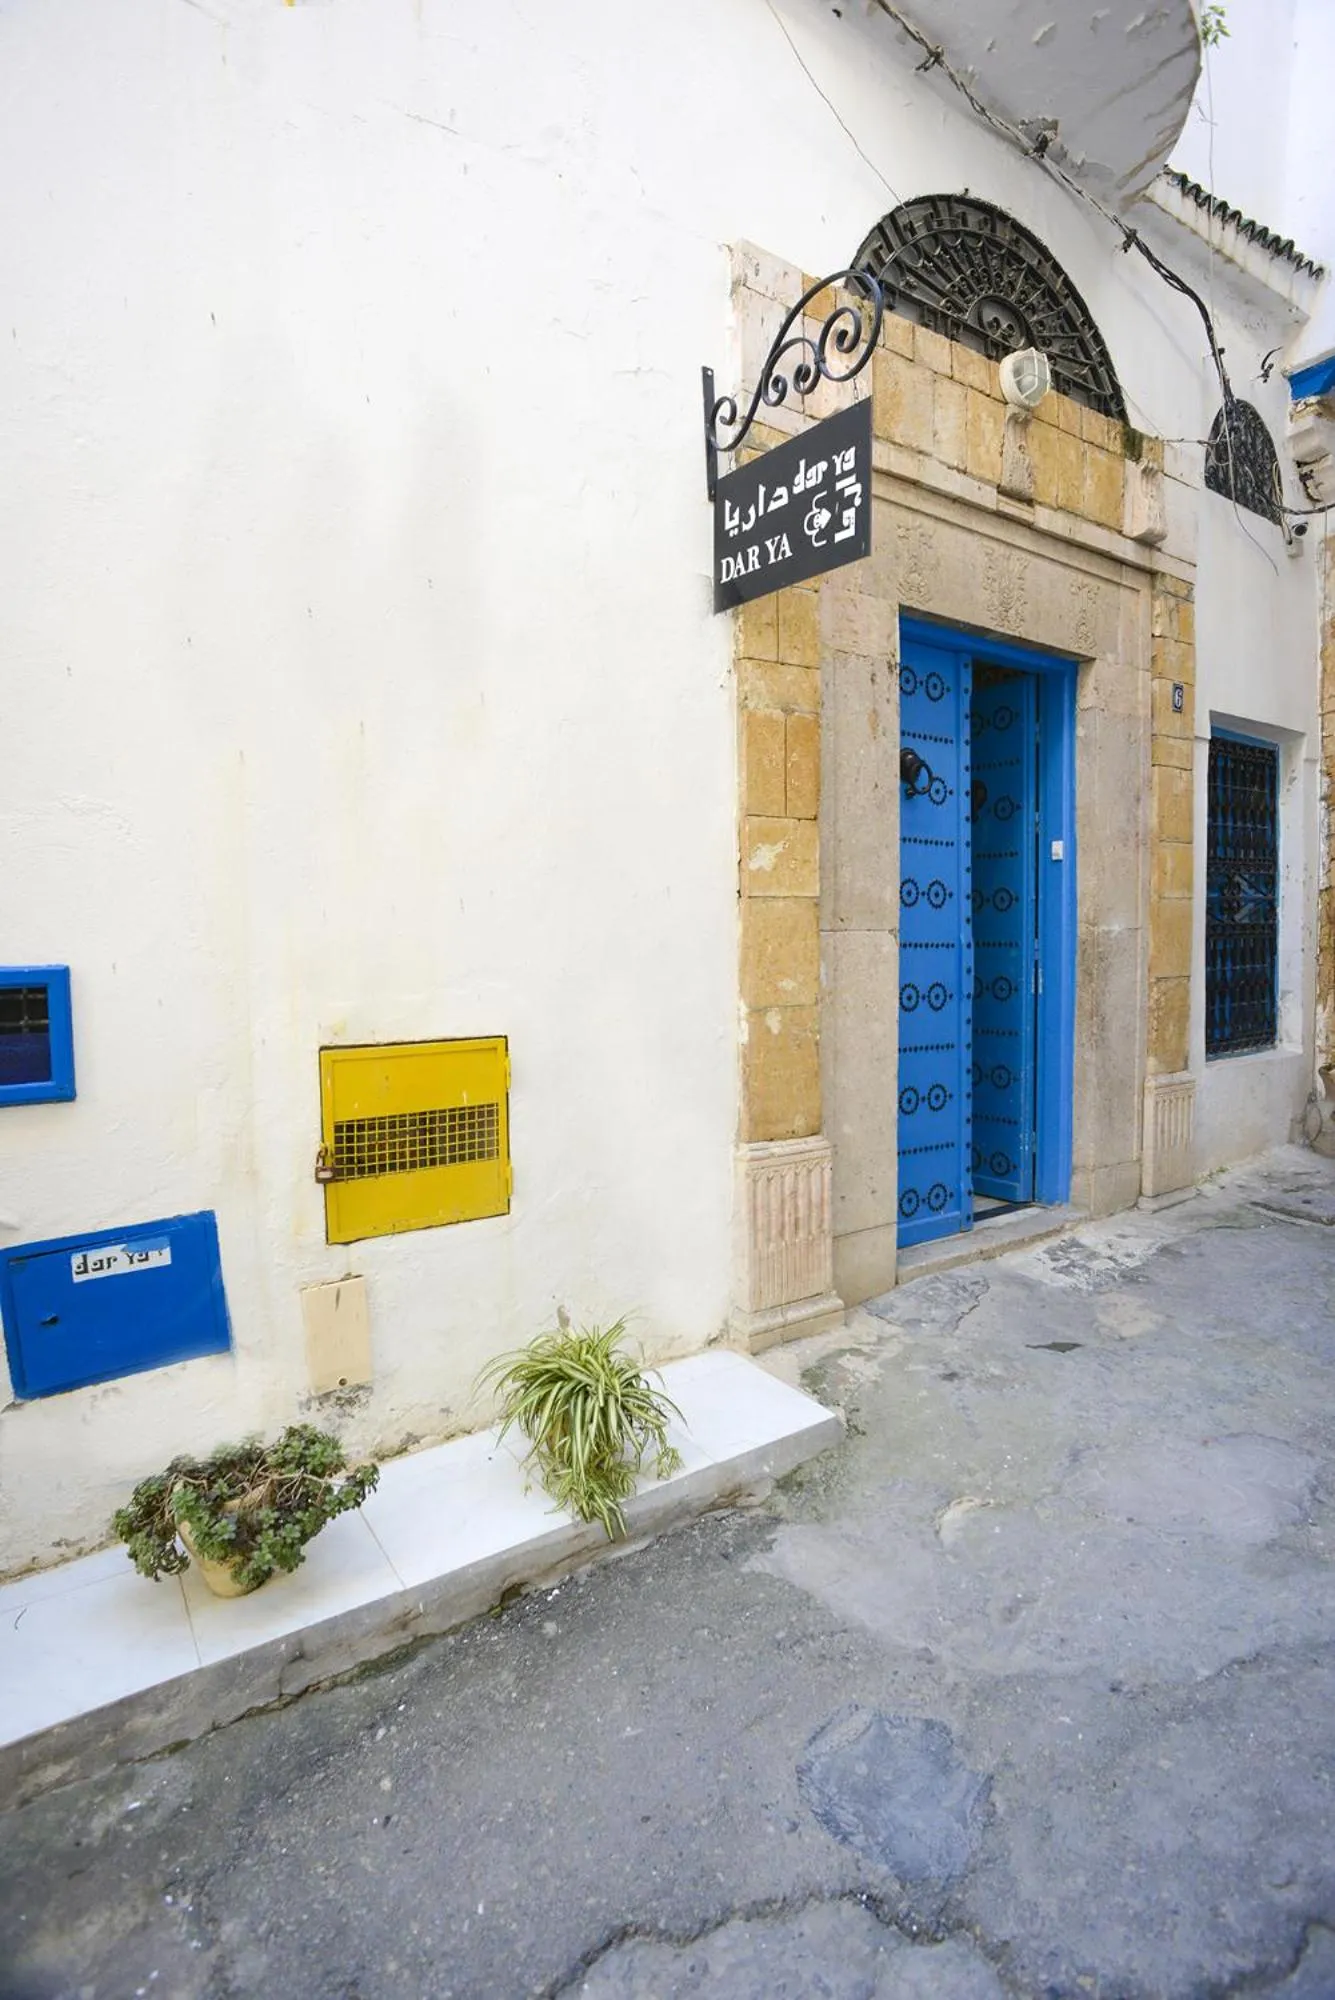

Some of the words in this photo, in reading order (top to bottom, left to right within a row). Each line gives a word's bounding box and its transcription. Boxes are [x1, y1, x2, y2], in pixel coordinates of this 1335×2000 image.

[792, 458, 828, 495] dar
[720, 545, 761, 584] DAR
[765, 532, 793, 565] YA
[75, 1254, 117, 1275] dar
